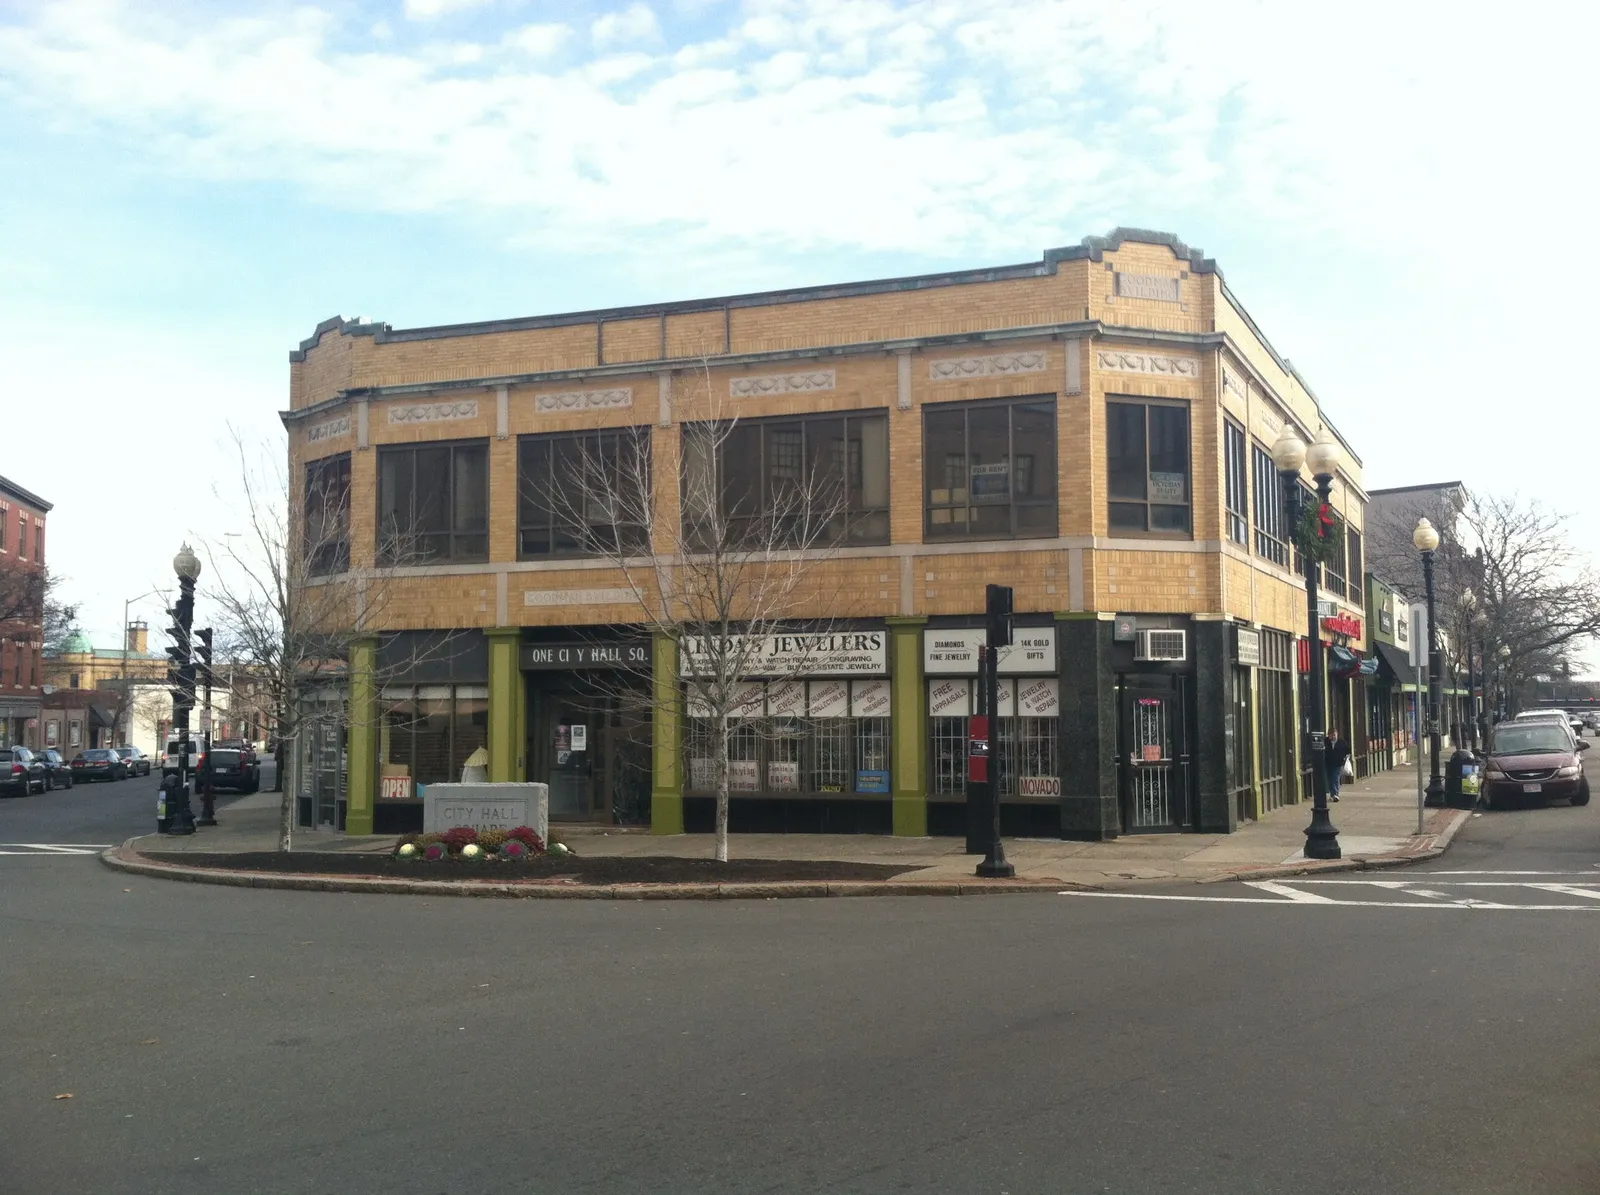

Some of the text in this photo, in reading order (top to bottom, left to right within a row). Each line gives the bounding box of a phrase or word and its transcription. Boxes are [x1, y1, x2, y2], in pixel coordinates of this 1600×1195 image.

[989, 465, 1008, 473] RENT
[769, 634, 881, 656] JEWELERS
[1033, 639, 1050, 647] GOLD
[532, 649, 553, 662] ONE
[591, 648, 621, 662] HALL
[829, 655, 872, 663] ENGRAVING
[1026, 652, 1044, 660] GIFTS
[769, 683, 795, 703] ESTATE
[853, 681, 882, 702] ENGRAVING
[932, 682, 954, 700] FREE
[1019, 680, 1047, 701] JEWELRY
[1030, 688, 1052, 706] WATCH
[741, 698, 762, 715] GOLD
[775, 691, 803, 713] JEWELRY
[811, 690, 847, 714] COLLECTIBLES
[862, 696, 888, 713] PREMISES
[867, 695, 876, 704] ON
[931, 688, 967, 714] APPRAISALS
[1035, 697, 1058, 714] REPAIR
[382, 779, 410, 797] OPEN
[1020, 779, 1060, 795] MOVADO
[443, 807, 519, 820] CITY HALL
